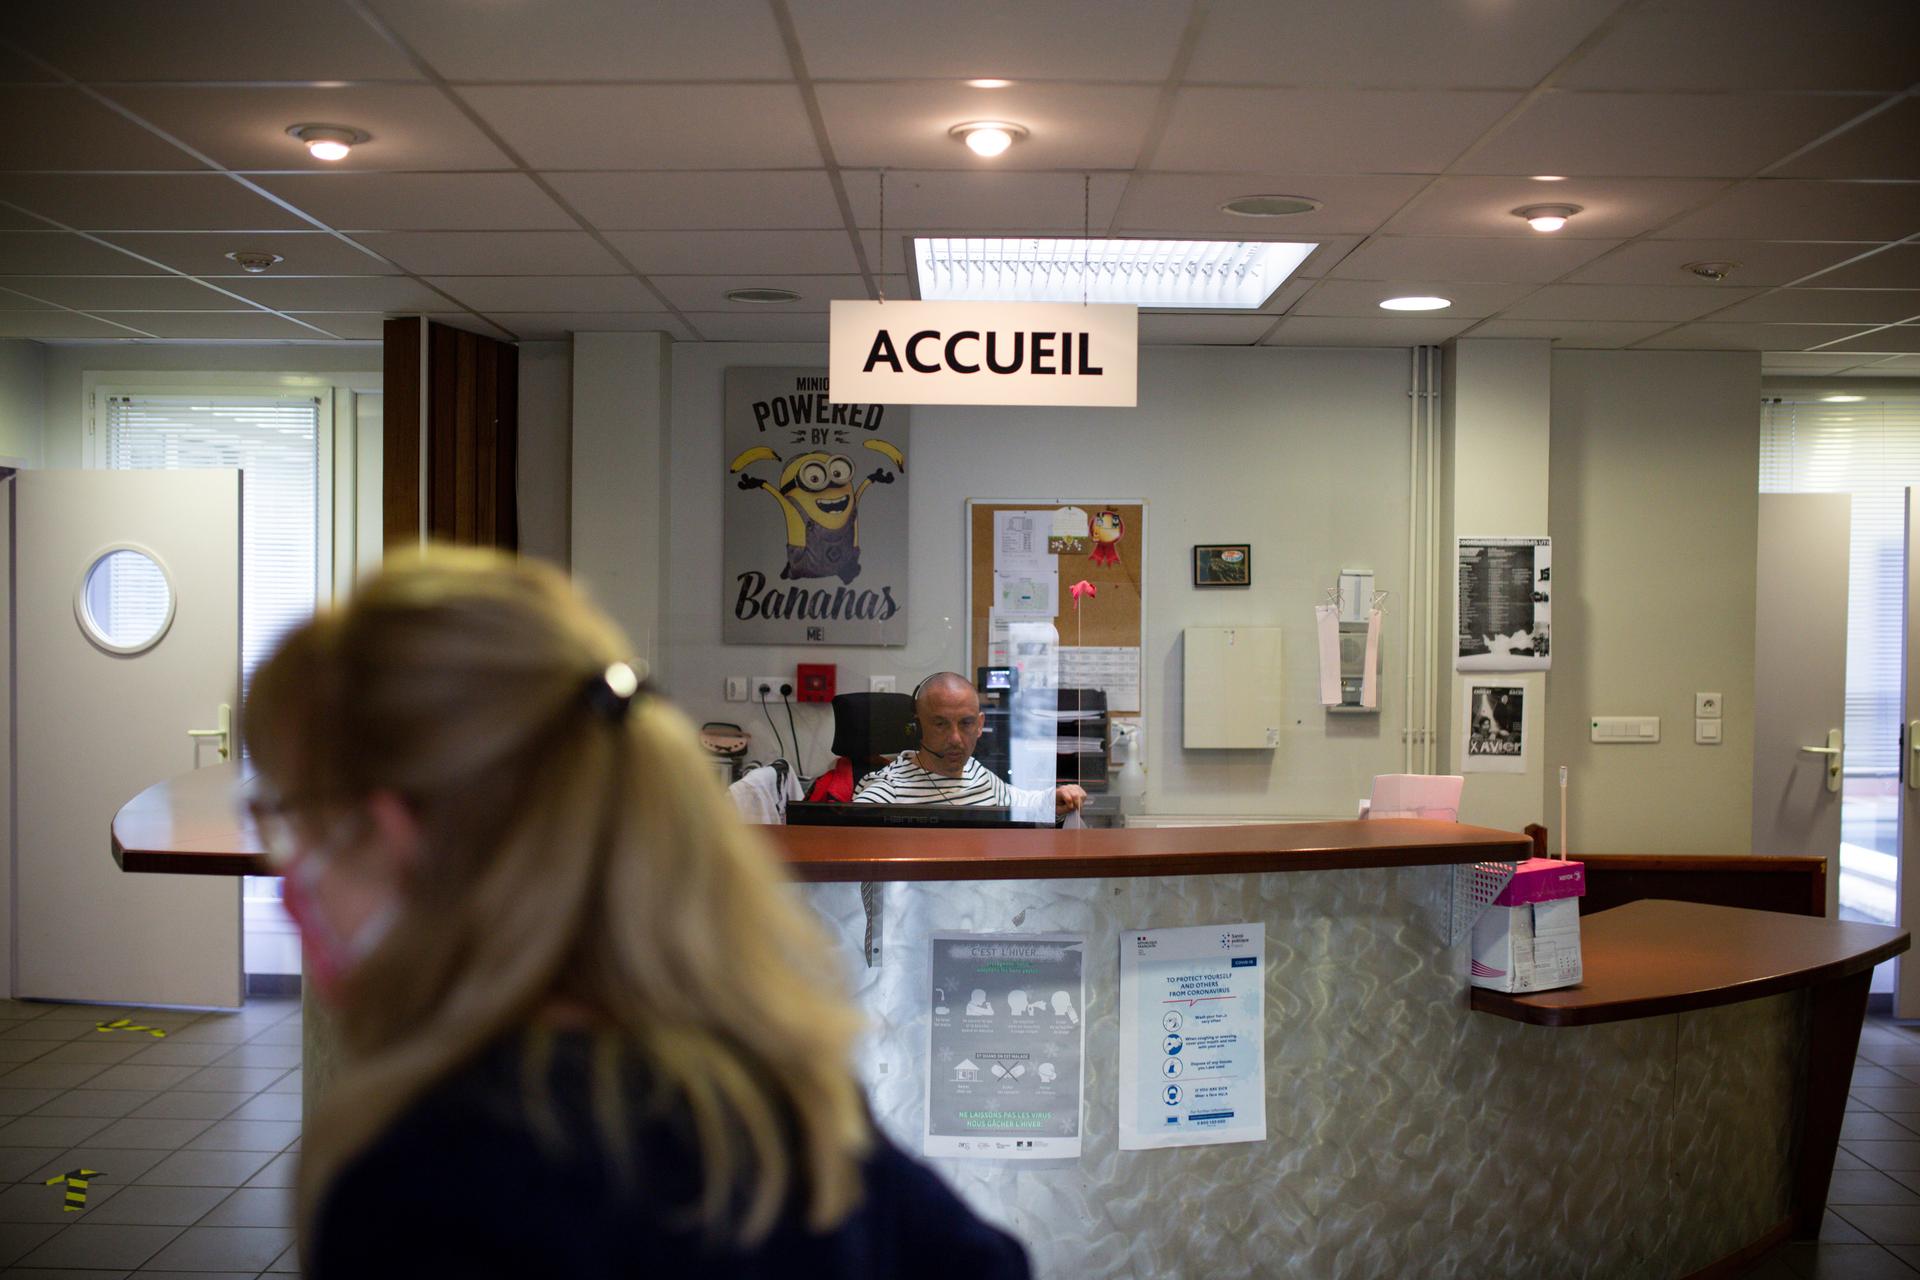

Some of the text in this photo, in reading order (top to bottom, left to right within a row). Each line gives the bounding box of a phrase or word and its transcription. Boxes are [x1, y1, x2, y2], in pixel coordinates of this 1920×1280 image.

[862, 329, 1103, 375] ACCUEIL
[796, 377, 829, 391] MINIO
[752, 394, 884, 432] POWERED
[811, 428, 829, 445] BY
[735, 571, 900, 621] Bananas
[971, 947, 996, 957] C'EST
[1176, 975, 1203, 983] PROTECT
[1203, 973, 1232, 981] YOURSELF
[1169, 987, 1230, 997] FROM CORONAVIRUS
[959, 1111, 969, 1119] NE
[969, 1111, 1002, 1119] LAISSONS
[967, 1120, 986, 1128] NOUS
[987, 1119, 1014, 1129] GÂCHER
